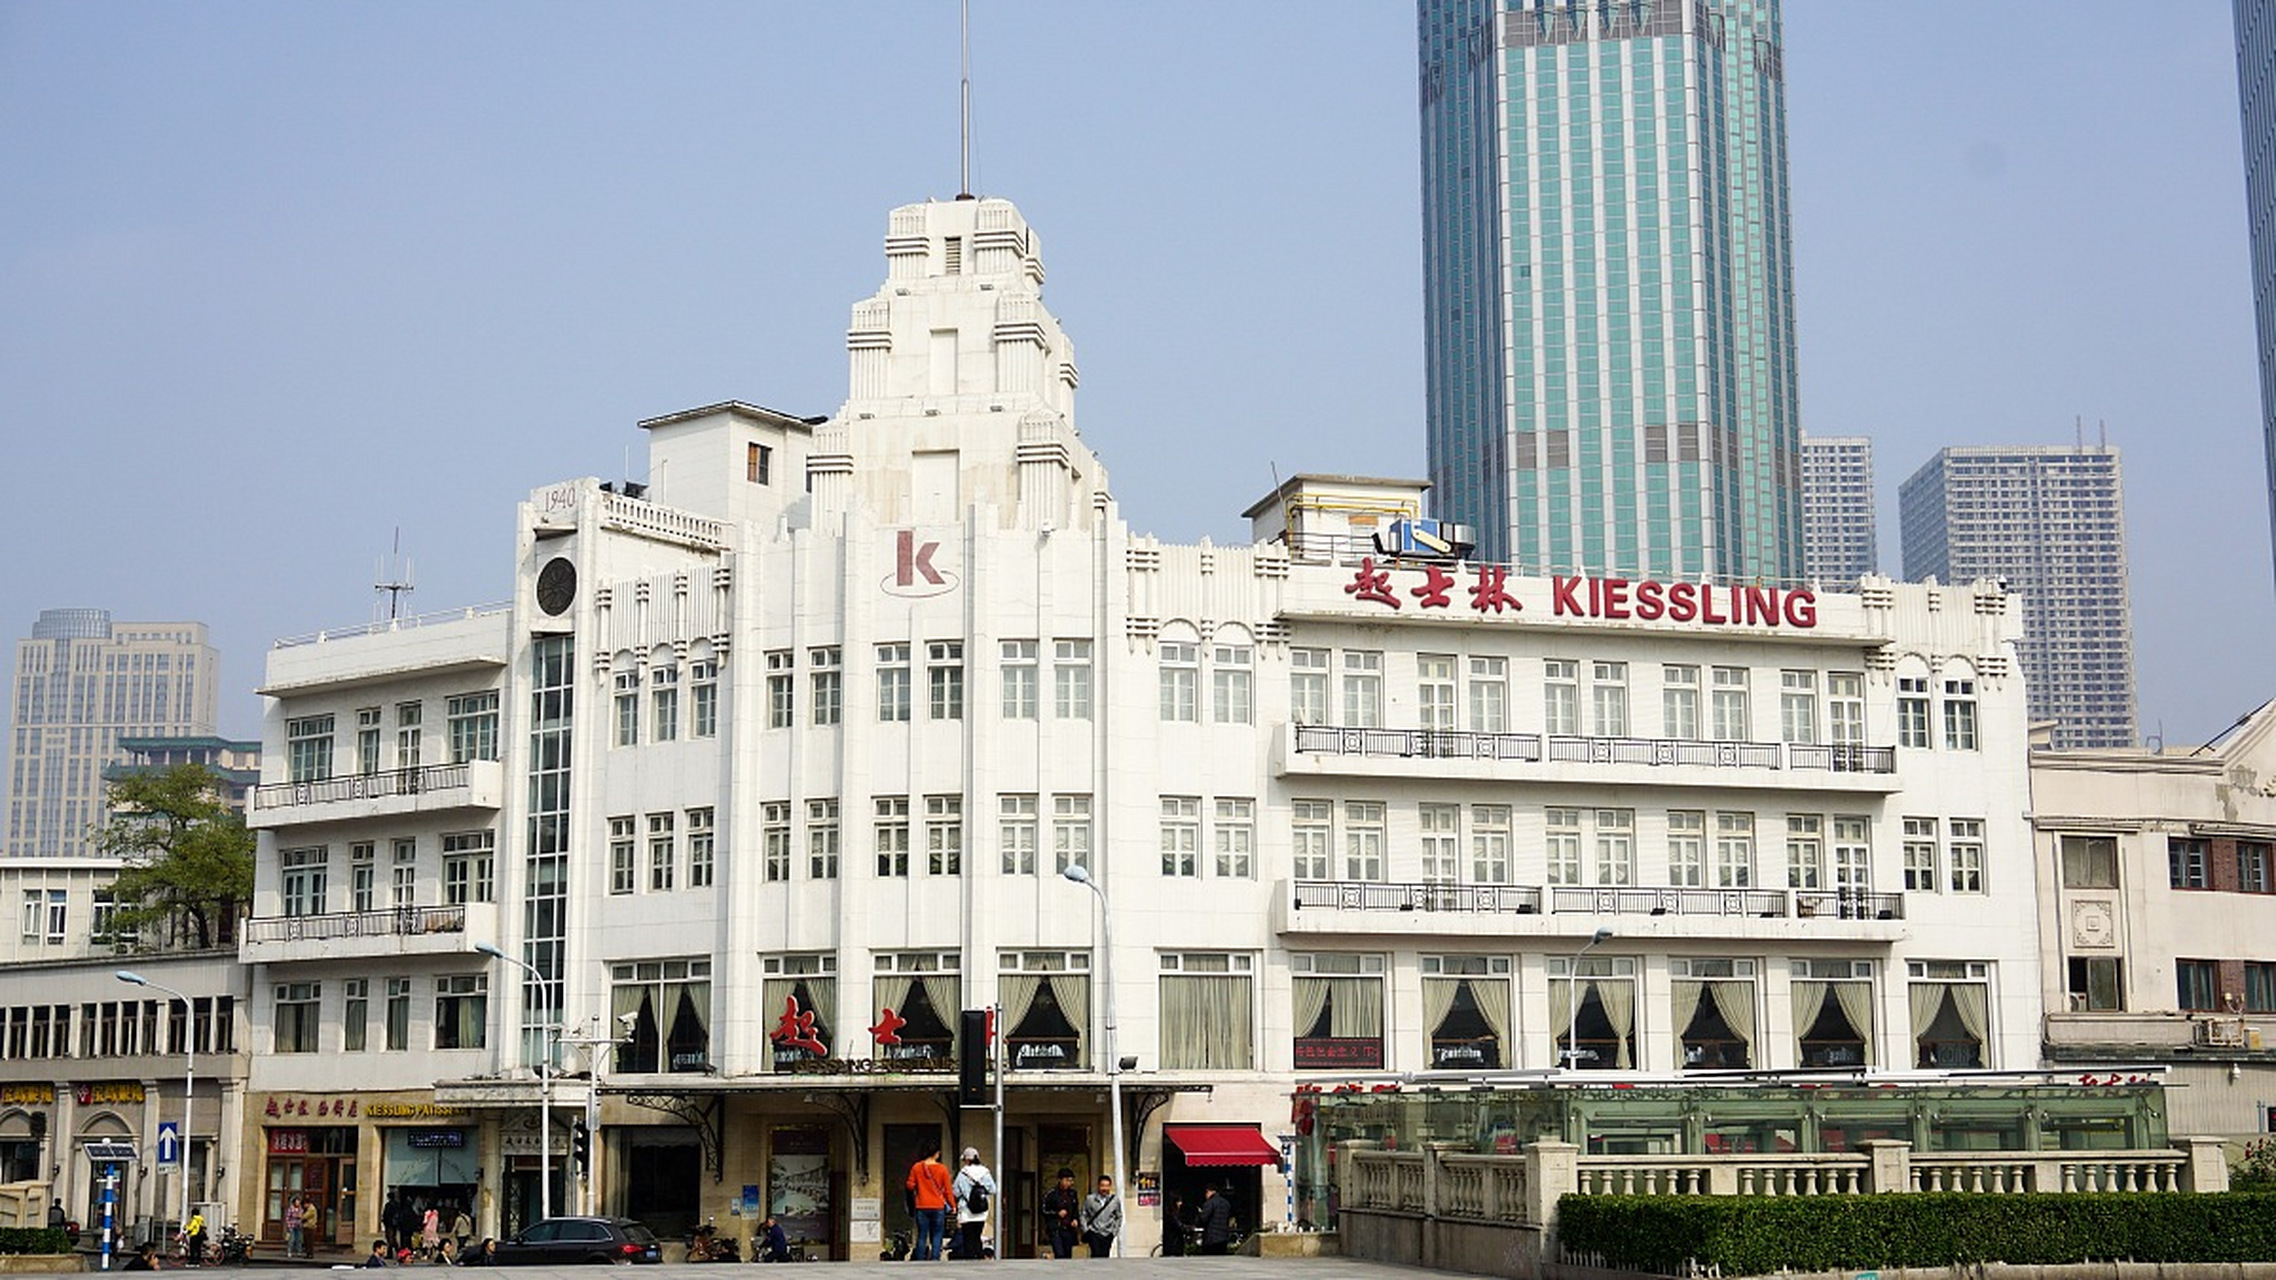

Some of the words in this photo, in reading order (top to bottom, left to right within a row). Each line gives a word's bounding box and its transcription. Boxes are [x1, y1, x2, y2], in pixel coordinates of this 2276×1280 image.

[545, 487, 576, 512] 1940
[897, 530, 946, 586] K
[1552, 574, 1818, 628] KIESSLING
[364, 1104, 416, 1117] KIESSLING
